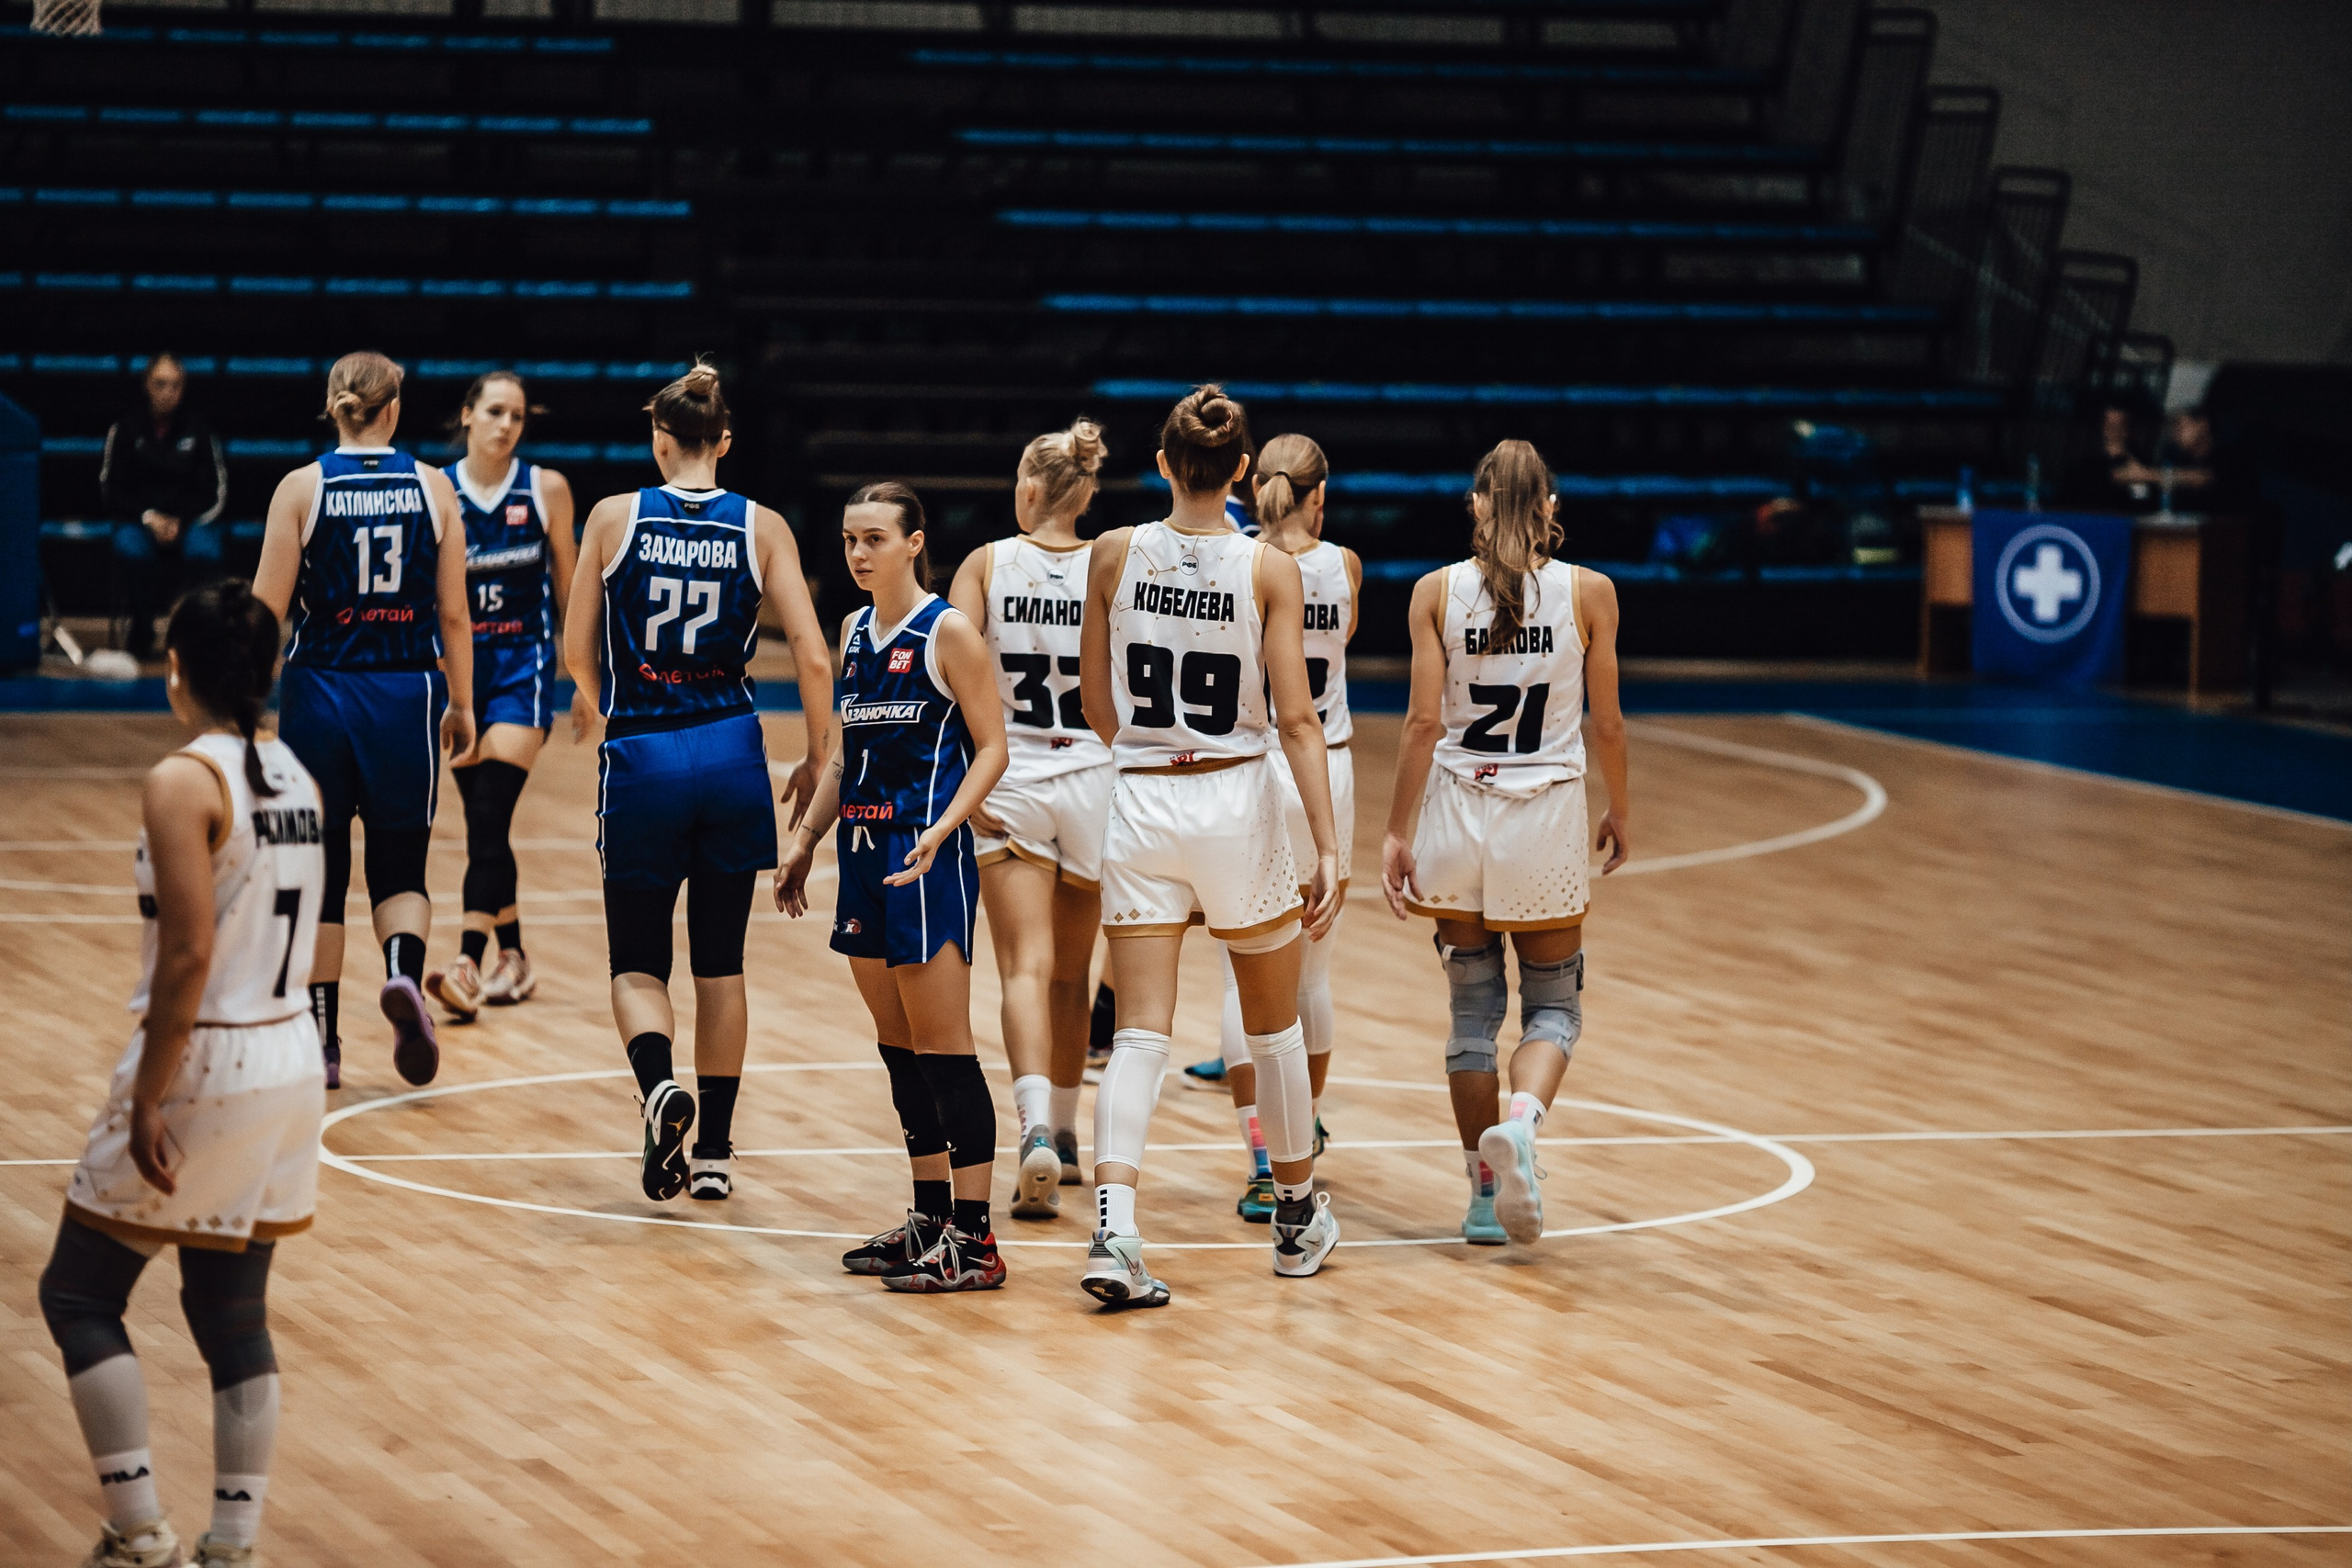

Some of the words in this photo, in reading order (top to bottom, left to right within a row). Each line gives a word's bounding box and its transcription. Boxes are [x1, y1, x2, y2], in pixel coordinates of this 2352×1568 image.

[353, 525, 402, 594] 13
[639, 533, 737, 569] ЗАХАРОВА
[478, 584, 503, 612] 15
[645, 576, 720, 654] 77
[1004, 596, 1086, 626] СИЛАНО
[1133, 581, 1234, 622] КОБЕЛЕВА
[891, 650, 912, 660] FON
[1465, 626, 1554, 655] БАОВА
[888, 660, 910, 670] BET
[1126, 642, 1241, 735] 99
[1461, 682, 1550, 753] 21
[857, 749, 869, 786] 1
[272, 888, 301, 998] 7
